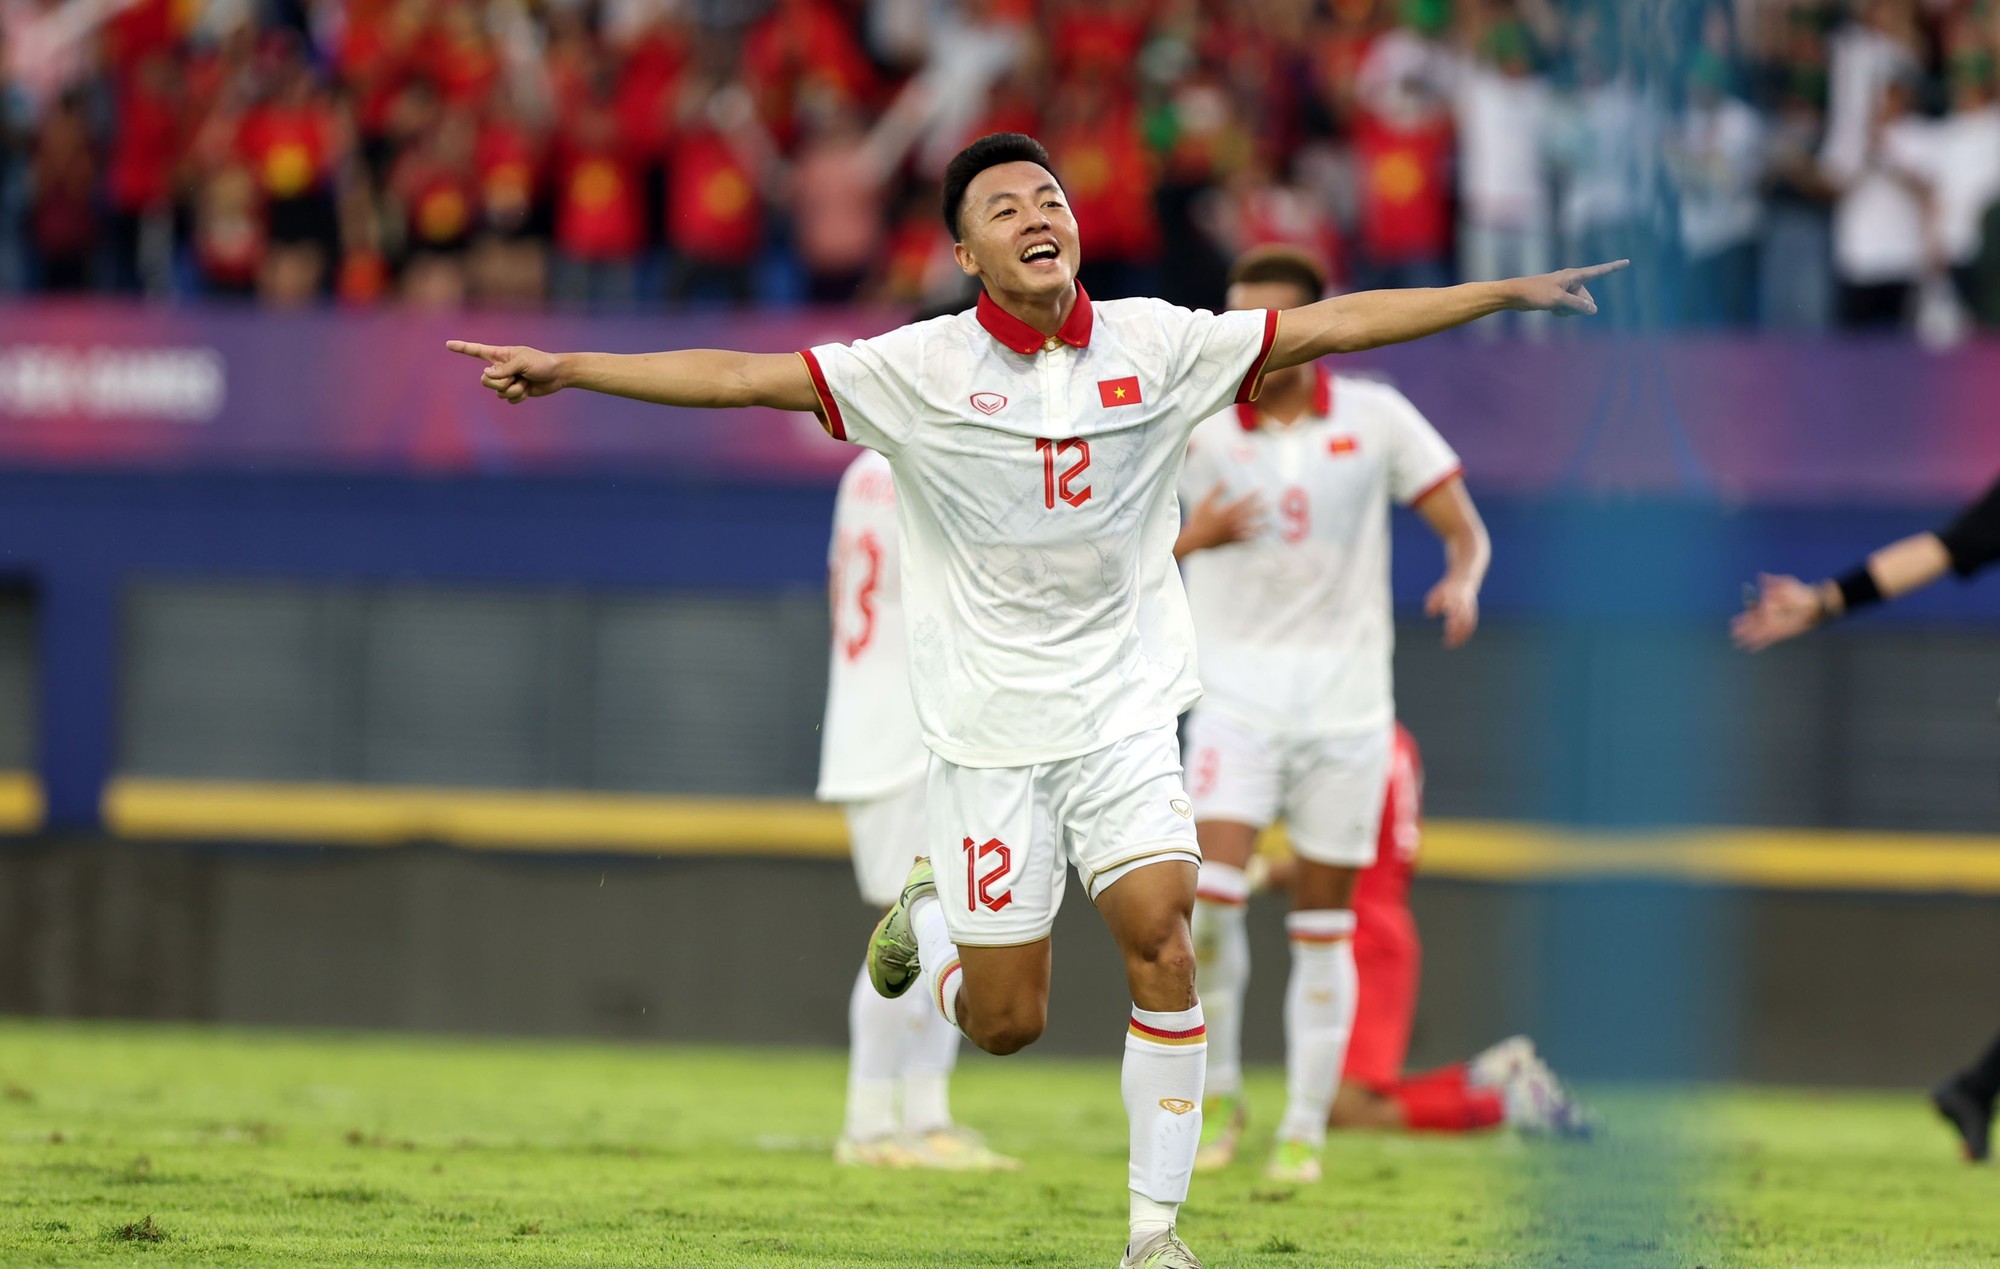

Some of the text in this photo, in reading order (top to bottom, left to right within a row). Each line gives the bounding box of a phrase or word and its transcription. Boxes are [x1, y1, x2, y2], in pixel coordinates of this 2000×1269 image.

[1035, 436, 1092, 510] 12
[1280, 487, 1310, 545] 9
[963, 836, 1013, 912] 12
